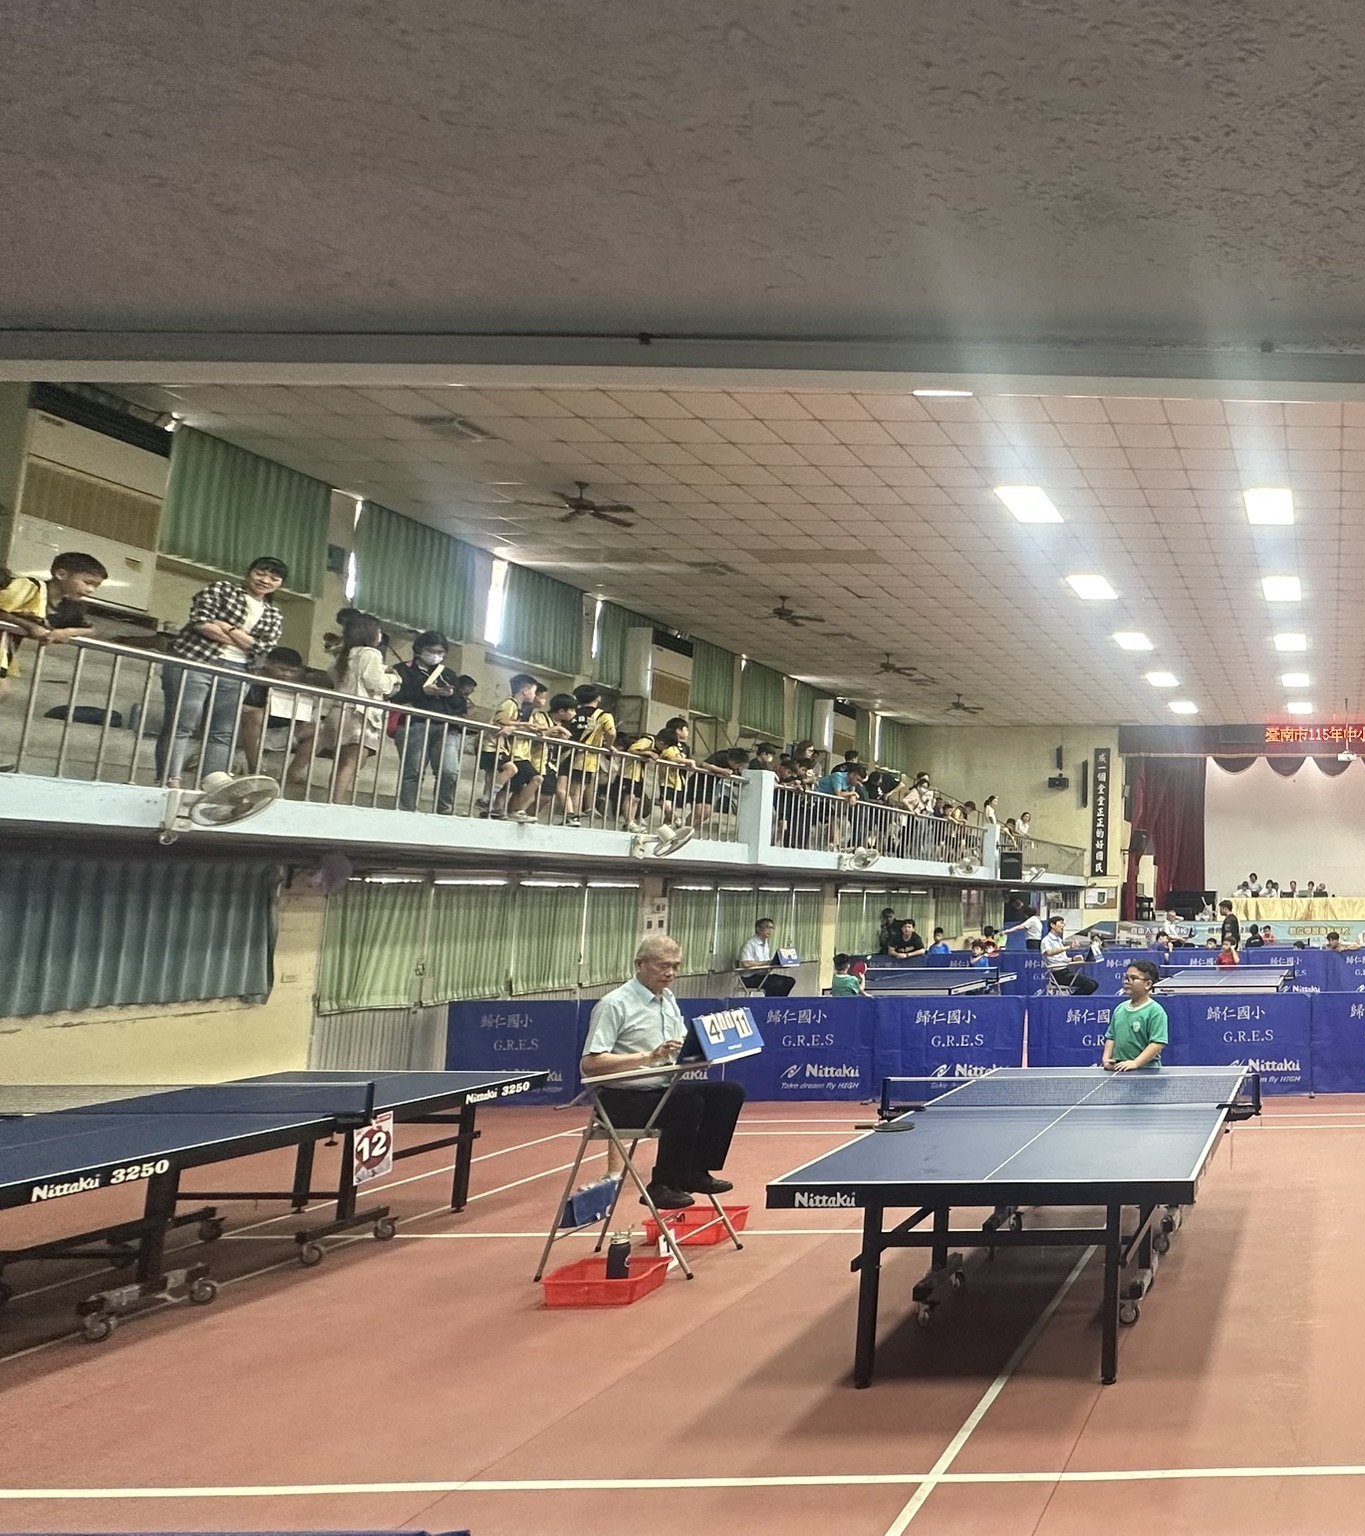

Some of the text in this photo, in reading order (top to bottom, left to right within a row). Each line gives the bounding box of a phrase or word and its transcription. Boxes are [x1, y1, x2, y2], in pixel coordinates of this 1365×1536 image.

[1190, 958, 1217, 966] 歸仁國
[1270, 957, 1303, 965] 歸仁國小
[480, 1013, 533, 1029] 歸仁國小
[766, 1009, 827, 1025] 歸仁國小
[915, 1009, 977, 1026] 歸仁國小
[1066, 1008, 1111, 1025] 歸仁國
[1206, 1005, 1266, 1022] 歸仁國小
[709, 1019, 720, 1040] 4
[736, 1014, 750, 1035] 11
[782, 1033, 834, 1047] G.R.E.S
[931, 1034, 984, 1047] G.R.E.S
[1082, 1034, 1105, 1047] G.R
[1223, 1029, 1274, 1042] G.R.E.S
[493, 1038, 539, 1051] G.R.E.S
[805, 1063, 860, 1078] Nittaku
[1248, 1058, 1301, 1072] Nittaku
[466, 1081, 530, 1105] Nittaku 3250
[781, 1082, 799, 1090] Take
[799, 1082, 825, 1090] dream
[826, 1082, 836, 1091] fly
[357, 1131, 387, 1162] 12
[31, 1159, 170, 1202] Nittaku 3250
[794, 1191, 856, 1208] Nittaku
